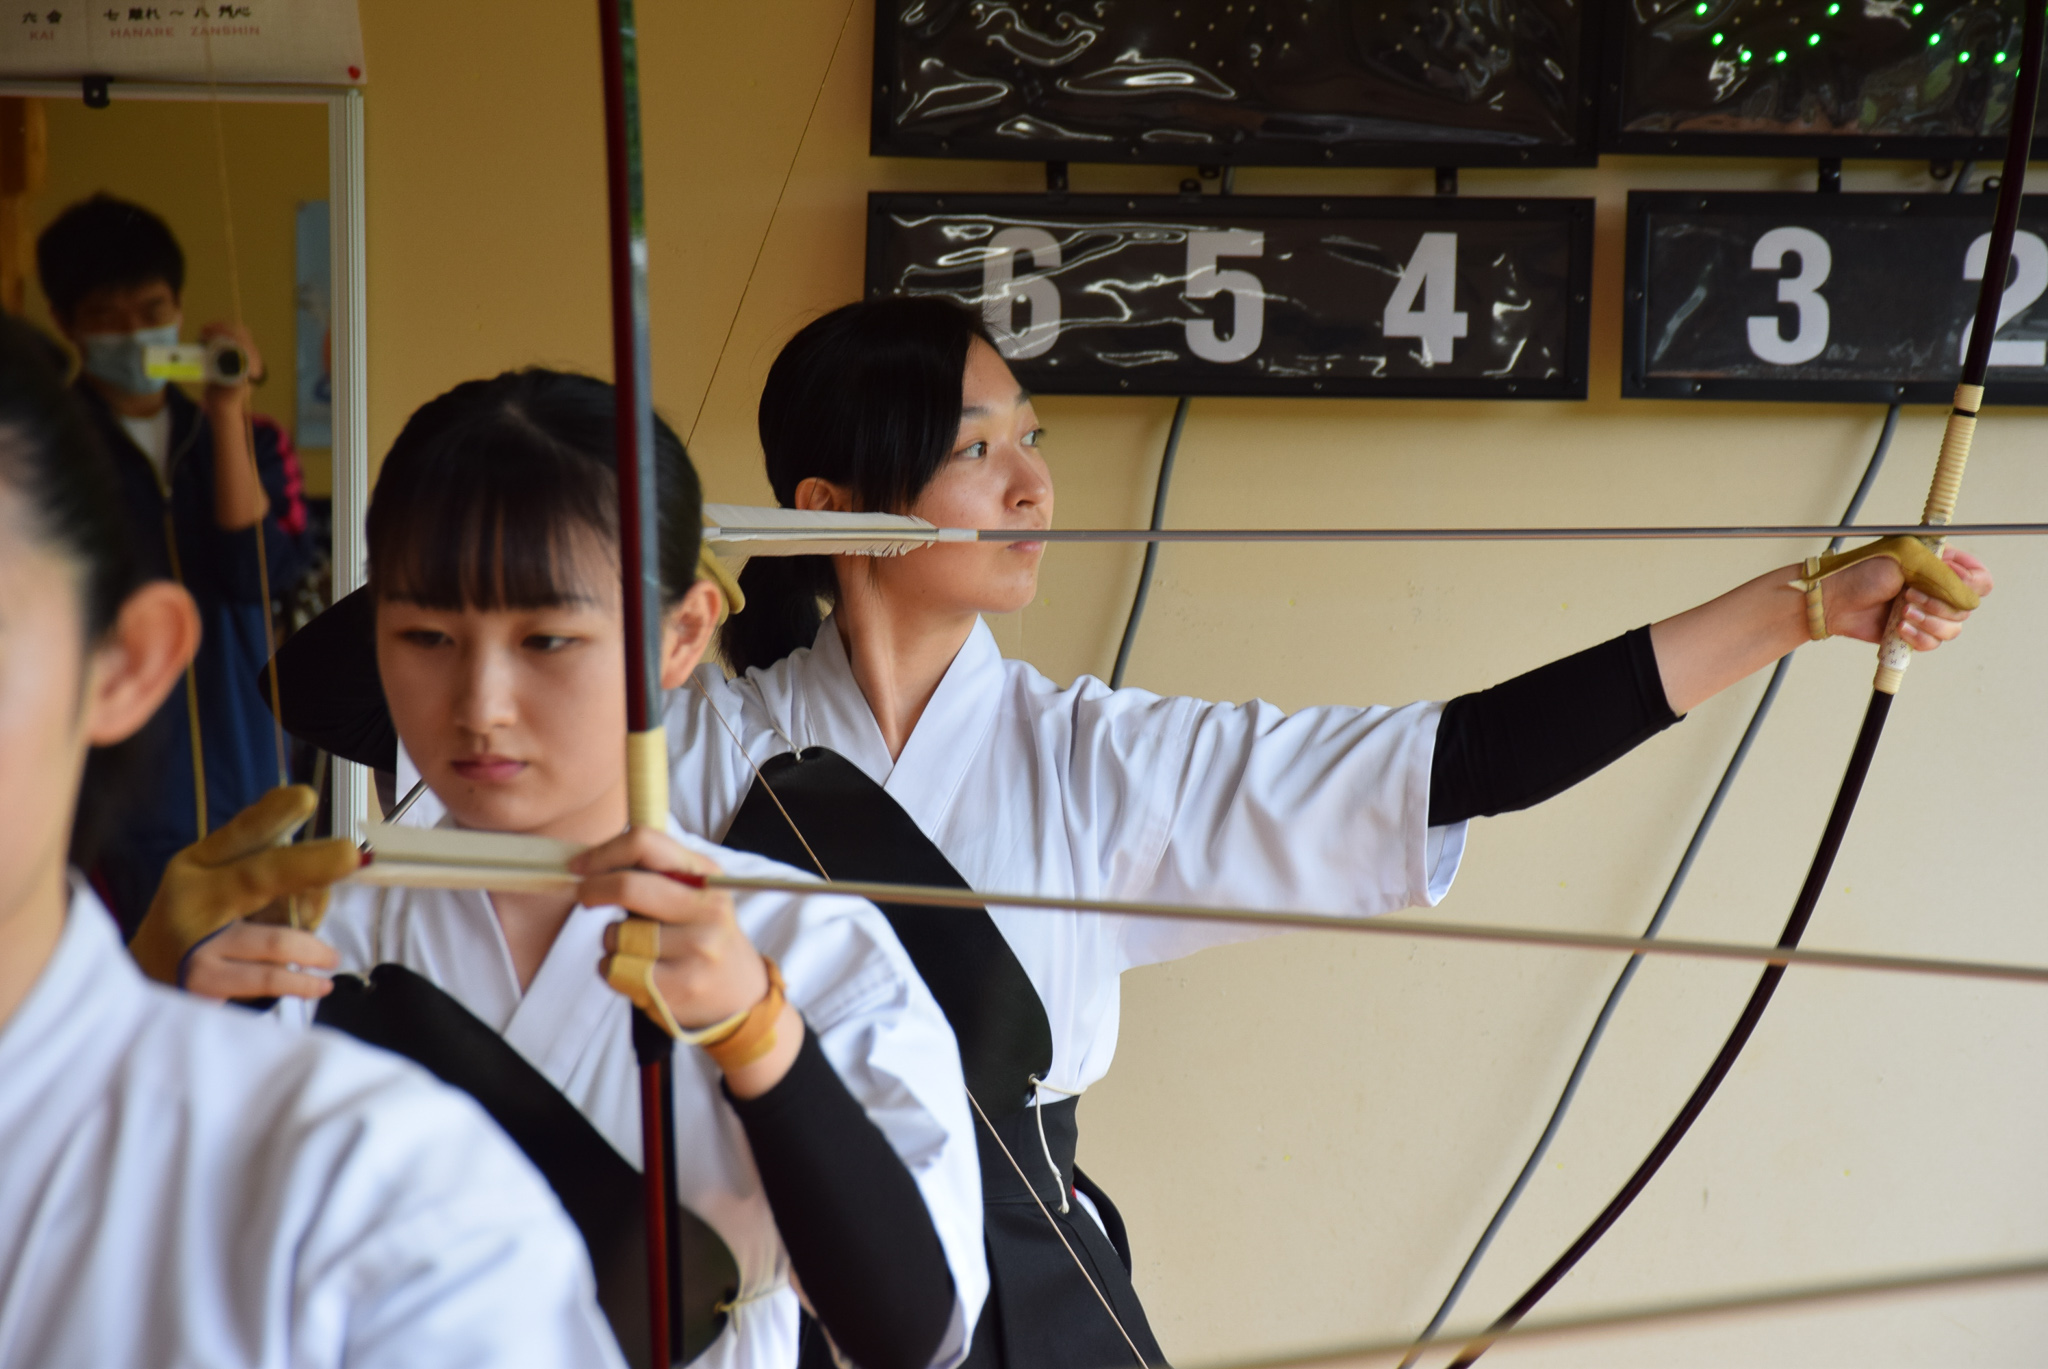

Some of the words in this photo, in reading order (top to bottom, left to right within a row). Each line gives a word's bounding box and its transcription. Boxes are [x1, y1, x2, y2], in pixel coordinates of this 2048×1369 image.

[29, 31, 55, 41] KAI
[110, 26, 175, 38] HANARE
[983, 228, 1062, 360] 6
[1184, 230, 1265, 363] 5
[1382, 232, 1468, 363] 4
[1747, 226, 1832, 365] 3
[1960, 229, 2048, 366] 2
